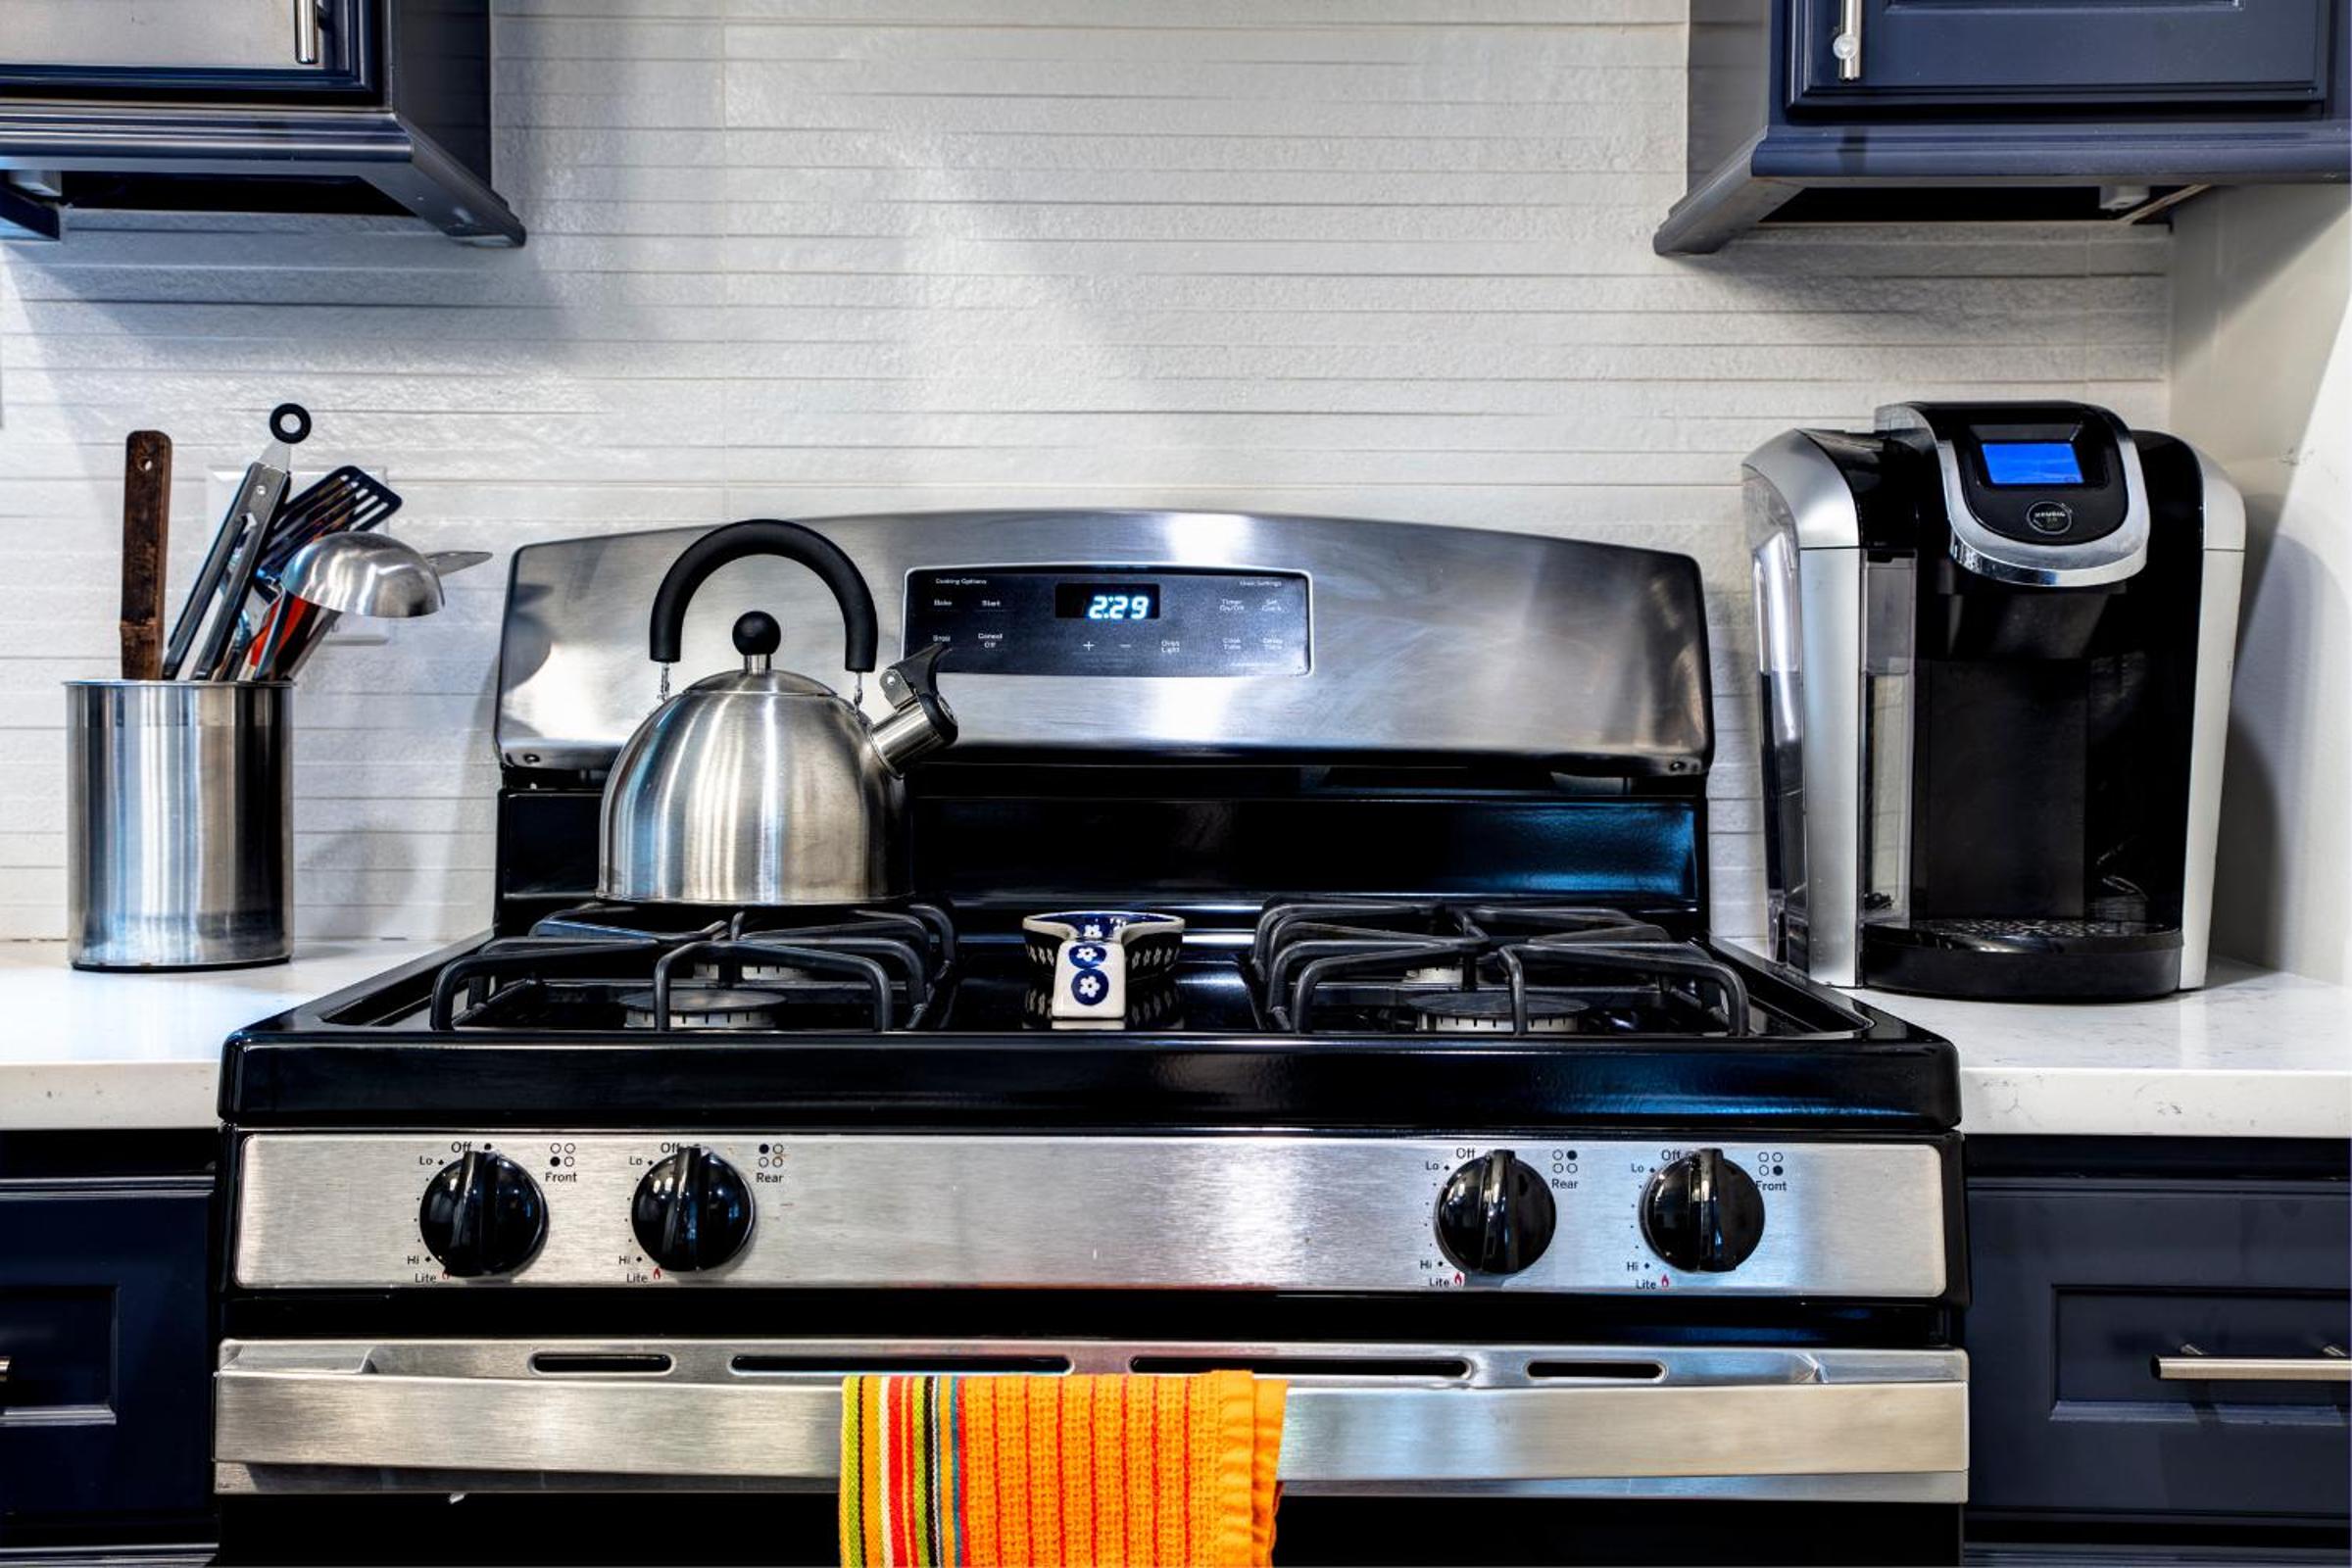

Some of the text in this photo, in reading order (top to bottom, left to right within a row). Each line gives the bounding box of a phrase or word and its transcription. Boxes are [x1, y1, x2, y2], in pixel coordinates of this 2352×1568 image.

[1088, 595, 1150, 619] 2:29
[451, 1142, 471, 1153] Off
[661, 1143, 680, 1153] Off
[1456, 1148, 1476, 1159] Off
[1661, 1150, 1681, 1160] Off
[419, 1155, 433, 1165] Lo
[629, 1156, 643, 1165] Lo
[1426, 1160, 1439, 1170] Lo
[1631, 1163, 1644, 1173] Lo
[545, 1172, 577, 1183] Front
[756, 1173, 784, 1183] Rear
[1551, 1179, 1579, 1189] Rear
[1755, 1181, 1788, 1192] Front
[407, 1254, 419, 1264] Hi
[618, 1255, 630, 1264] Hi
[1420, 1260, 1433, 1269] Hi
[1627, 1262, 1640, 1271] Hi
[415, 1273, 437, 1284] Lite
[626, 1273, 649, 1284] Lite
[1429, 1277, 1450, 1287] Lite
[1636, 1280, 1657, 1290] Lite
